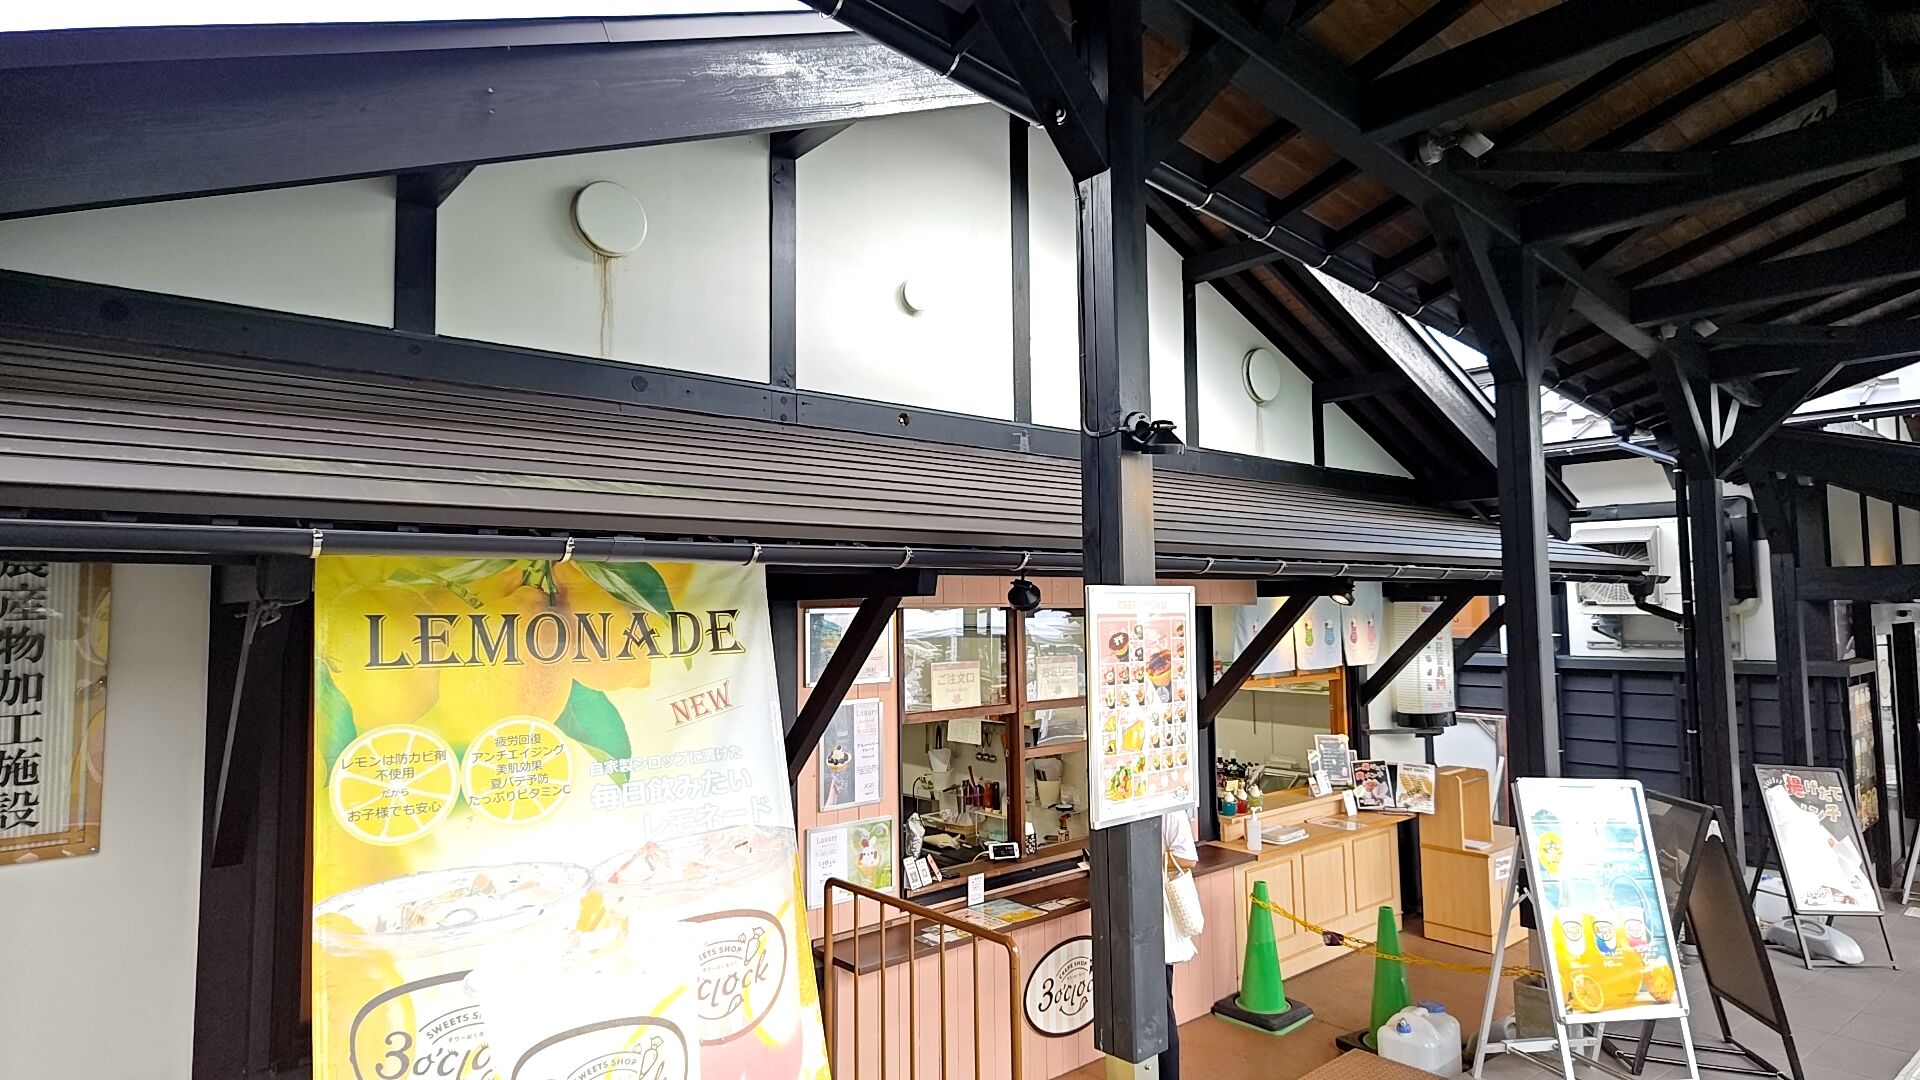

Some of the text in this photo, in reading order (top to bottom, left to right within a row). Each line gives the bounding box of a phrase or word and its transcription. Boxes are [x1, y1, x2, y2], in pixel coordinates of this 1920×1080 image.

[364, 609, 747, 669] LEMONADE
[937, 672, 975, 686] ご注文口
[670, 680, 734, 726] NEW
[495, 733, 542, 748] 疲労回復
[341, 749, 447, 770] レモンは防カビ剤
[472, 744, 565, 764] アンチエイジング
[375, 767, 415, 781] 不使用
[496, 760, 543, 776] 美肌効果
[490, 773, 549, 791] 夏バテ予防
[590, 767, 753, 812] 毎日飲みたい
[381, 788, 410, 799] だから
[347, 801, 442, 823] お子様でも安心
[643, 795, 772, 841] レモネード
[719, 945, 743, 954] SHOP
[1038, 978, 1094, 1013] 3o'cloc
[426, 1014, 469, 1040] SWEETS
[573, 1061, 609, 1080] WEETS
[611, 1058, 638, 1067] SHOP
